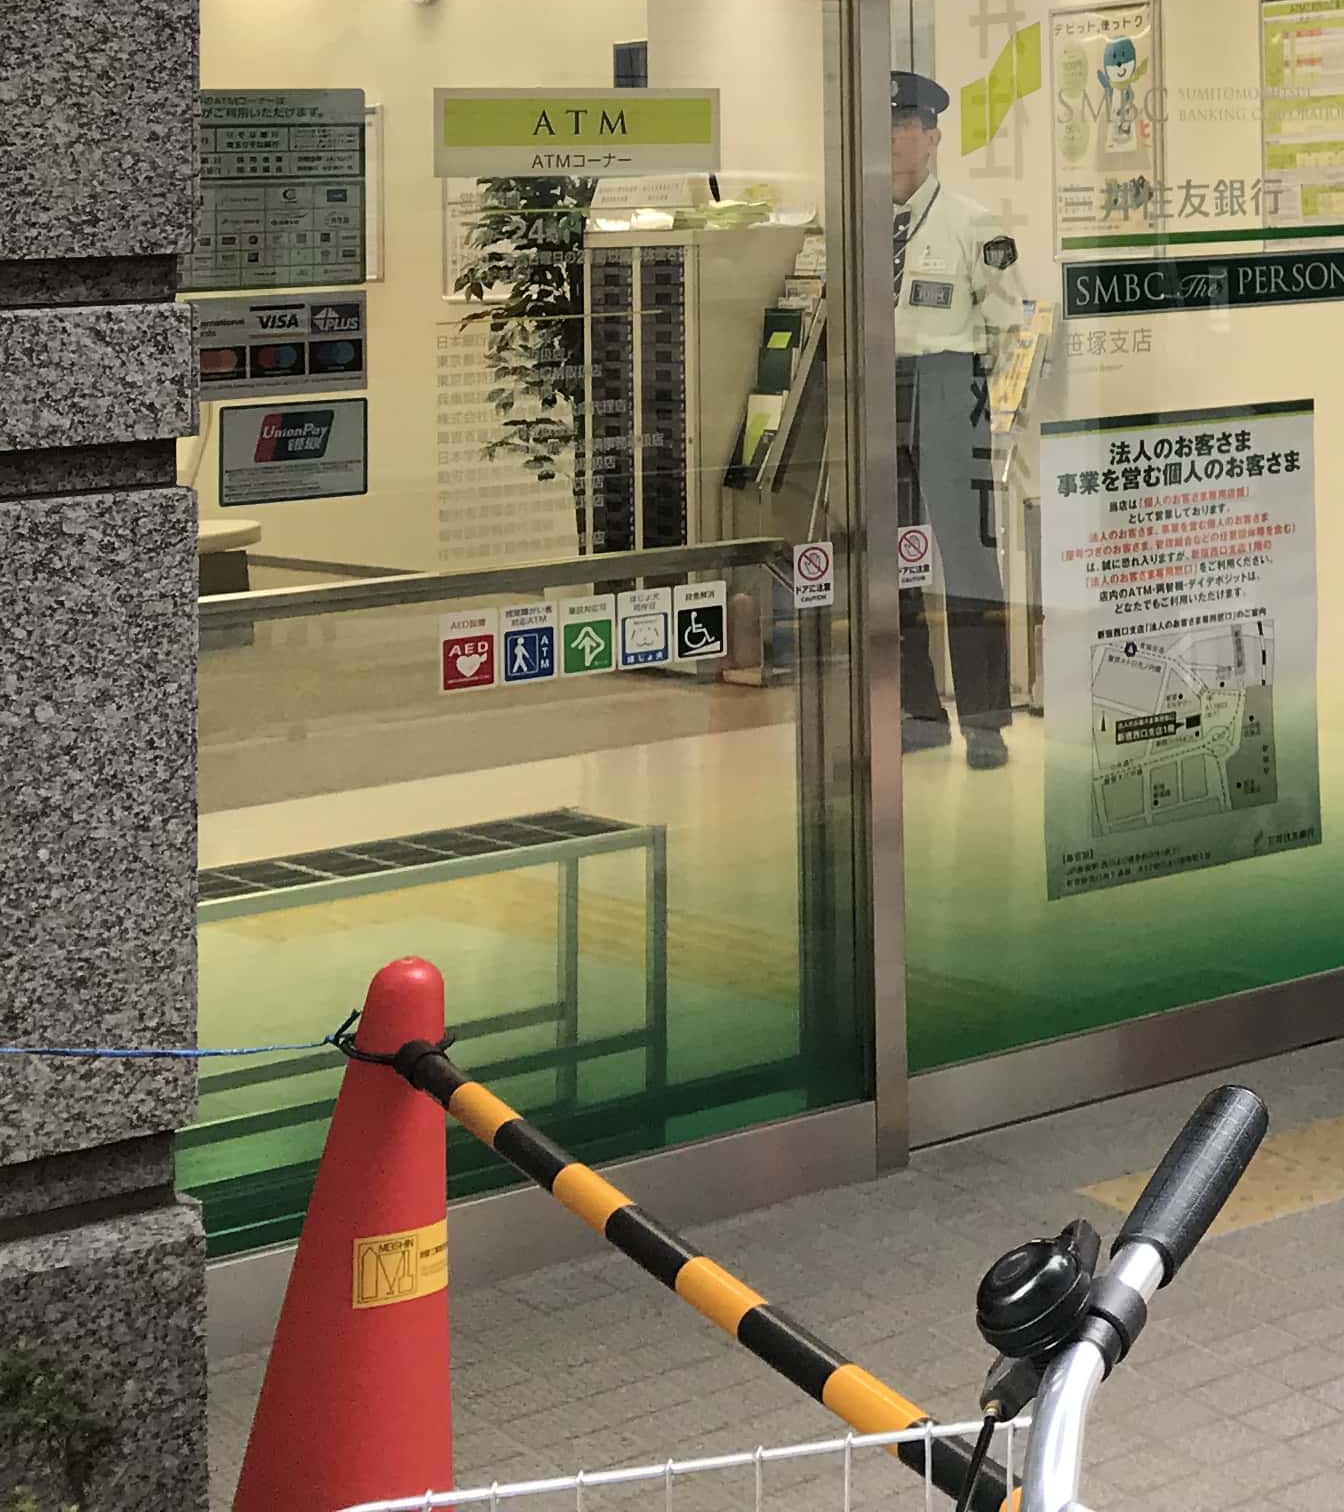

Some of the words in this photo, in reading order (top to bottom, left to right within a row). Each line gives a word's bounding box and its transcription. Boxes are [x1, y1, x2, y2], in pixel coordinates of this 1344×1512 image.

[533, 109, 628, 136] ATM
[531, 152, 633, 170] ATMコーナー
[1060, 177, 1284, 223] 三井住友銀行
[1075, 271, 1166, 306] SMBC
[1176, 270, 1228, 299] The
[258, 313, 300, 330] VISA
[262, 422, 329, 440] UnionPay
[1110, 430, 1252, 466] 法人のお客さま
[1056, 450, 1301, 498] 事業を営む個人のお客さま
[448, 641, 489, 657] AED
[540, 635, 550, 669] ATM
